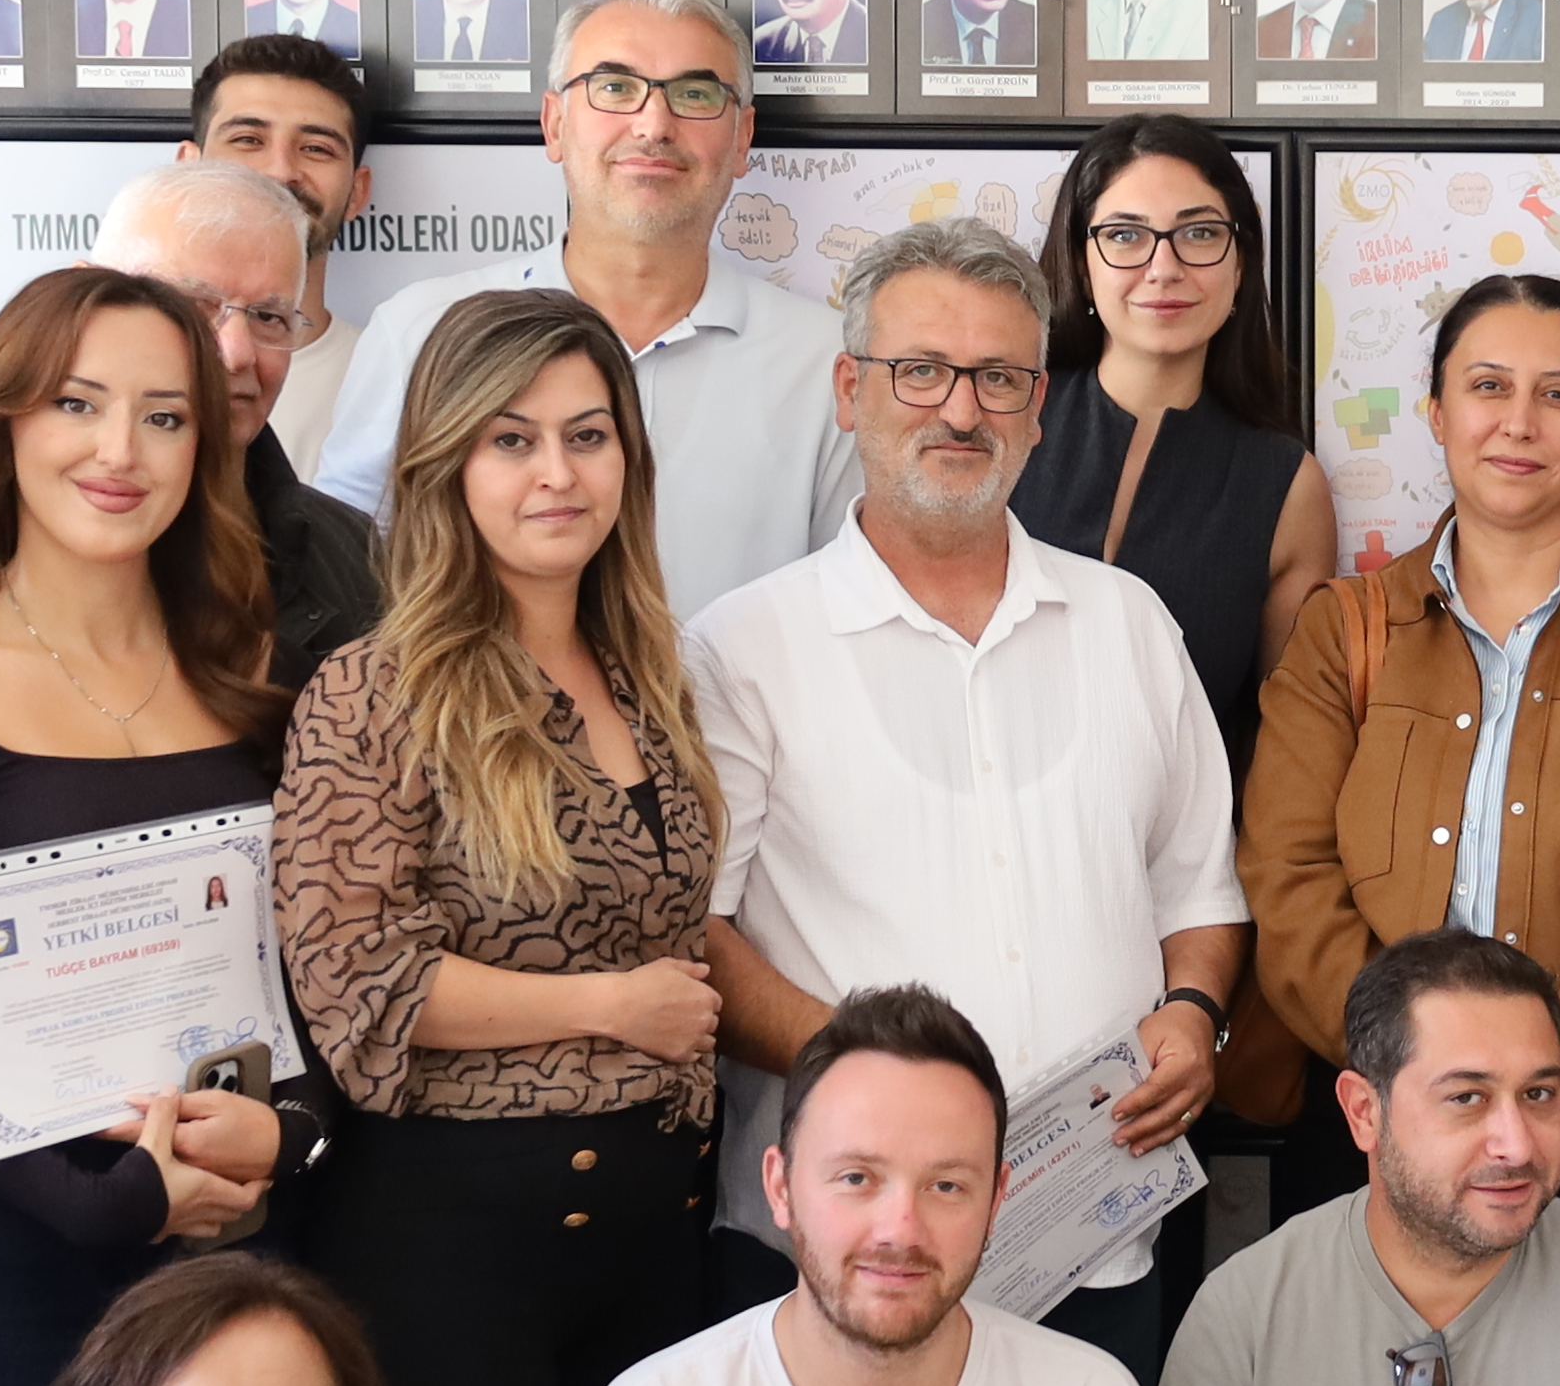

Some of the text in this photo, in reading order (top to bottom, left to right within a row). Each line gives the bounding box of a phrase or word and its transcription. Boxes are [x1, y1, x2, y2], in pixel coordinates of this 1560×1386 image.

[121, 69, 151, 77] Cemal
[438, 70, 501, 80] Sami DOĞAN
[773, 75, 801, 83] Mahir
[967, 76, 1029, 86] Gürol ERGİN
[1126, 84, 1156, 92] Gökhan
[771, 152, 857, 182] HAFTASI
[1357, 184, 1391, 198] ZMO
[12, 205, 553, 253] TMMO NDİSLERİ ODASI
[1355, 233, 1413, 262] İKLİM
[42, 909, 179, 952] YETKİ BELGESİ
[45, 958, 86, 979] TUĞÇE
[89, 947, 139, 969] BAYRAM
[1009, 1119, 1072, 1171] BELGESİ
